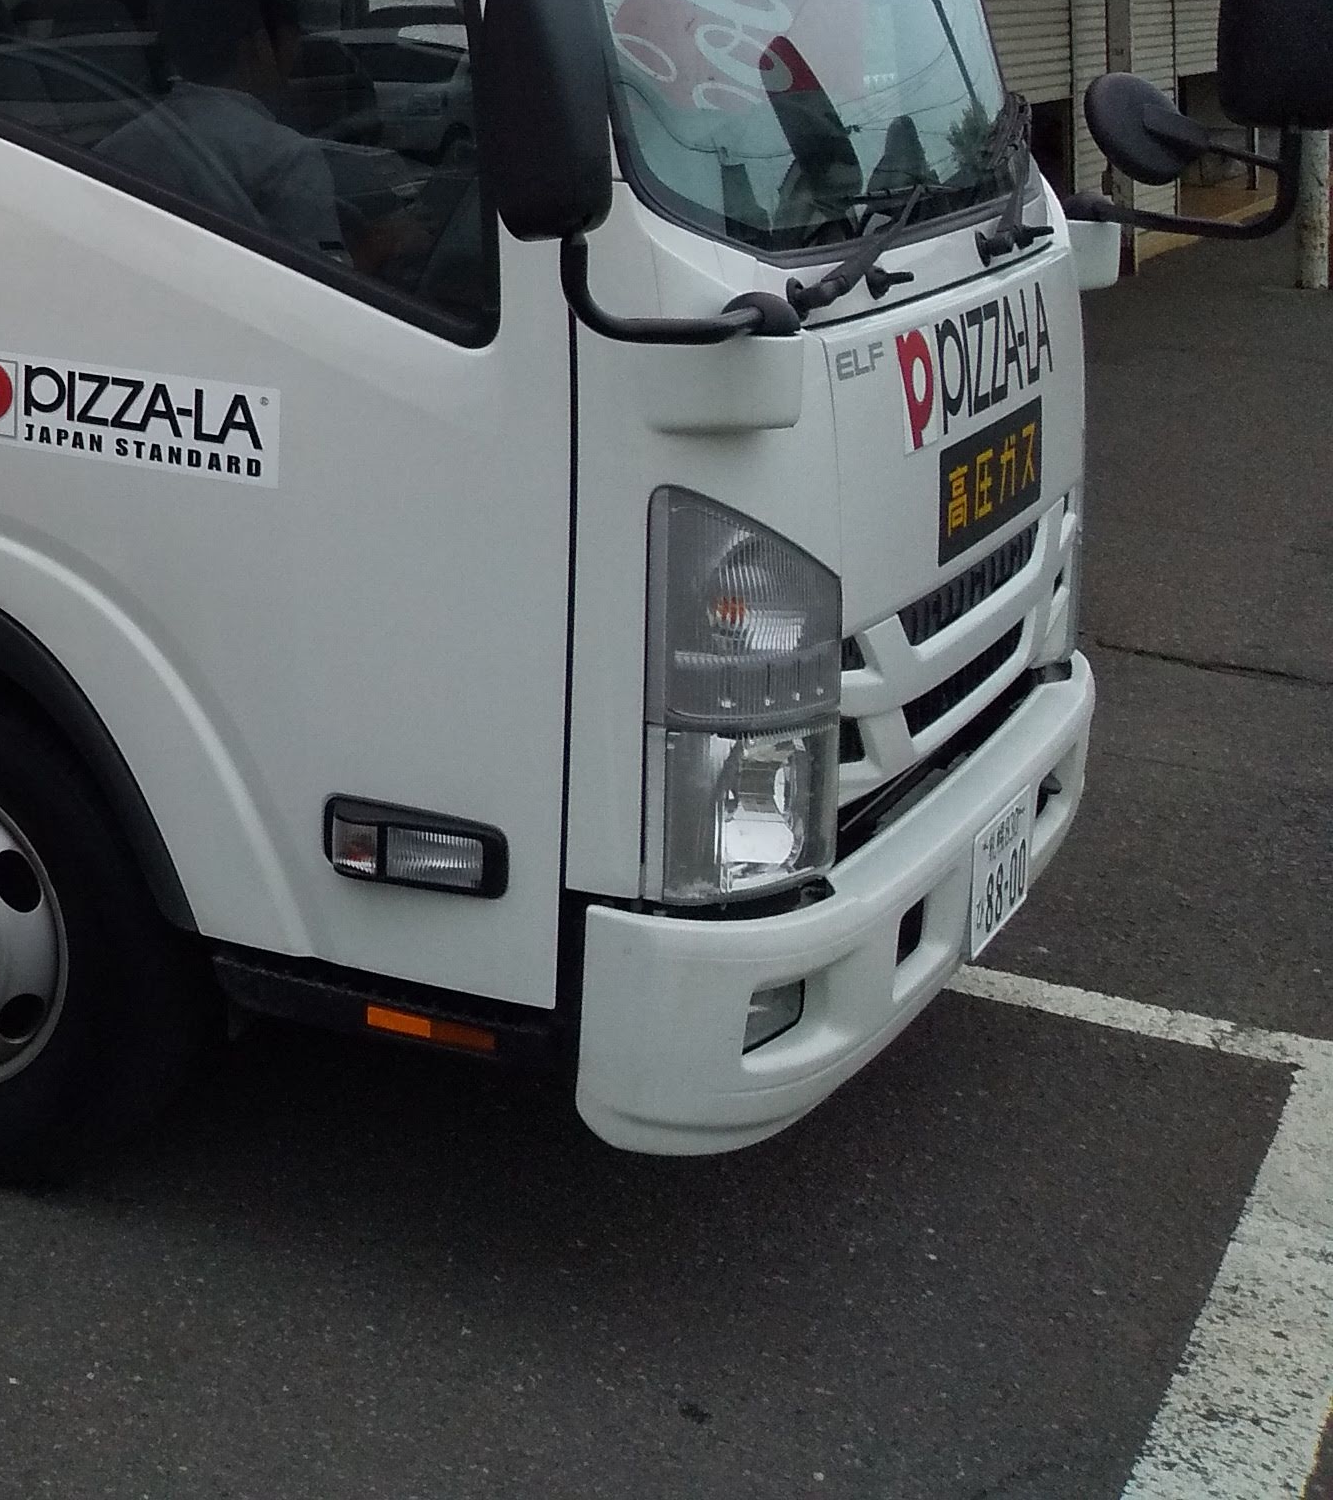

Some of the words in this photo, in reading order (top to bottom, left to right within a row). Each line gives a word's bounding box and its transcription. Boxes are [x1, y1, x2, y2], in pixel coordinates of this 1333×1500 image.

[836, 342, 884, 381] ELF
[25, 424, 103, 453] JAPAN
[115, 438, 261, 477] STANDARD
[948, 421, 1036, 538] 高圧ガス
[986, 839, 1026, 933] 88-00
